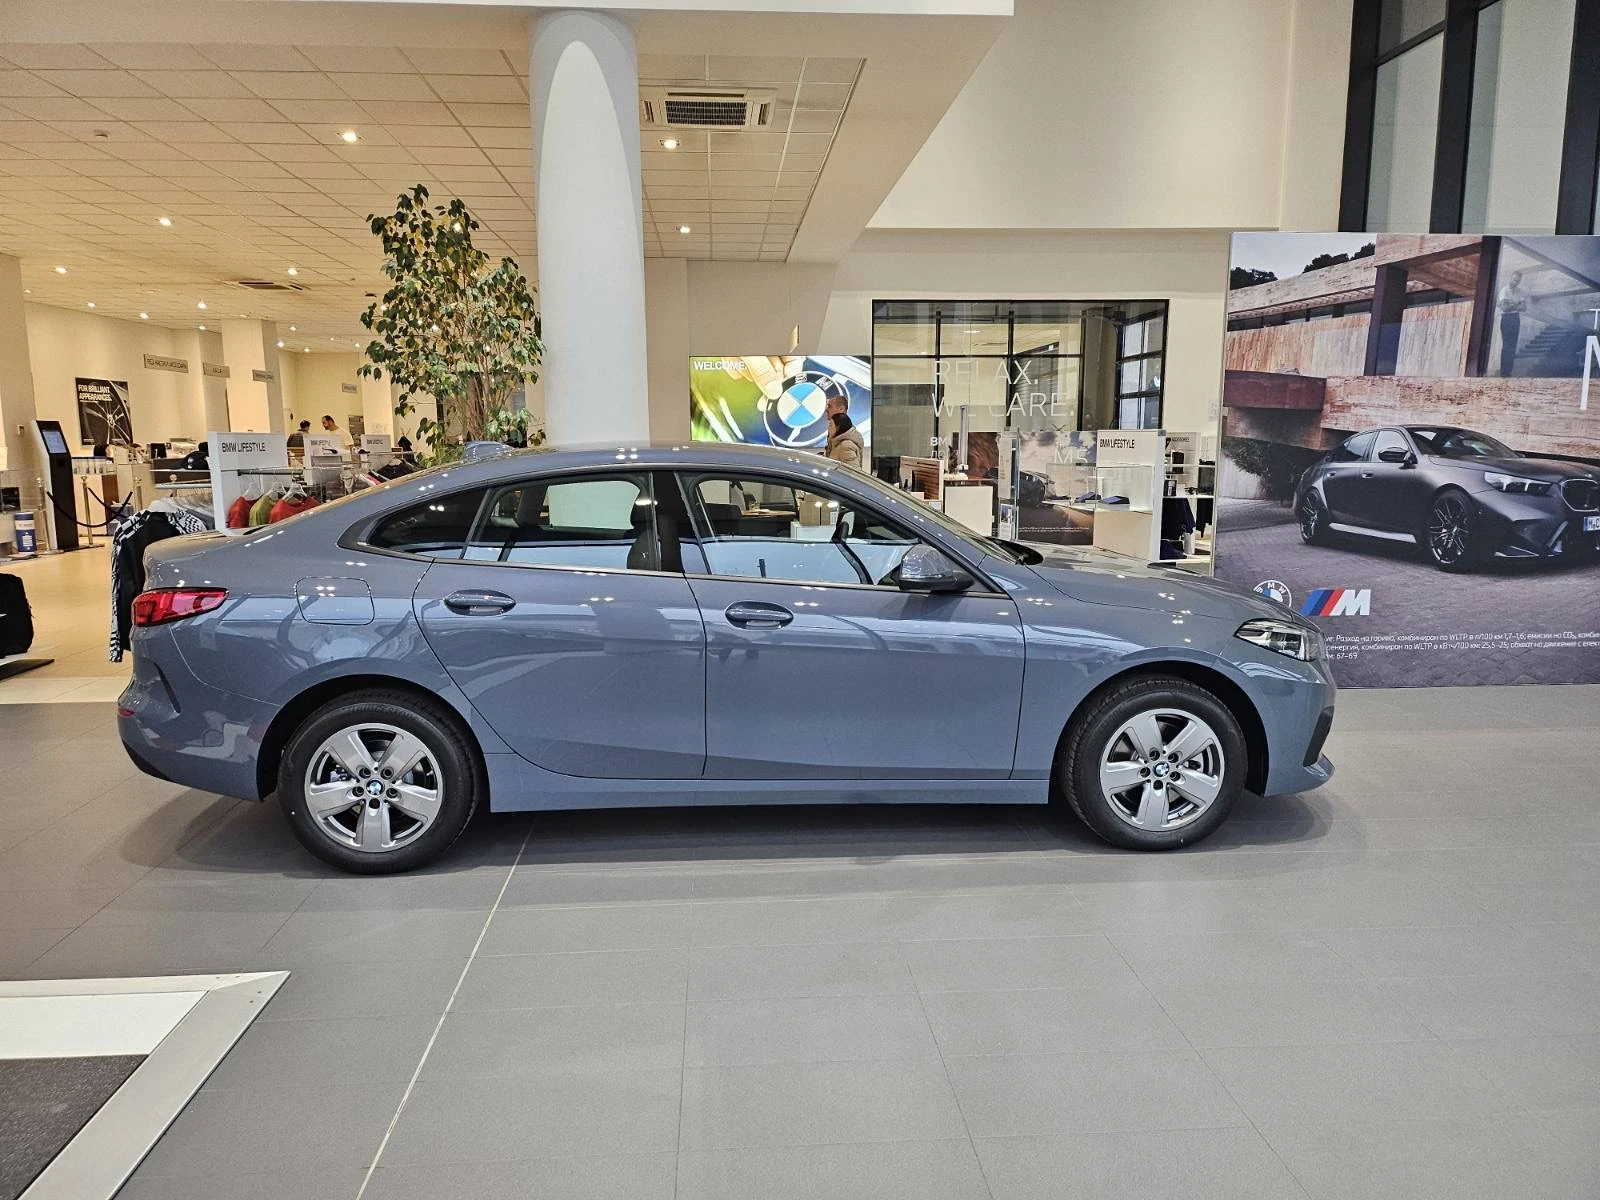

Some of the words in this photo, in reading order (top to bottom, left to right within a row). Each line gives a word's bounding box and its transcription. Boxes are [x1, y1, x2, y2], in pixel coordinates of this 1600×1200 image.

[933, 360, 1039, 385] RELAX.
[78, 384, 88, 392] FOR
[88, 385, 111, 393] BRILLIANT
[221, 442, 236, 452] BMW
[237, 442, 266, 452] LIFESTYLE
[1100, 438, 1110, 448] BMW
[1110, 439, 1135, 449] LIFESTYLE
[1449, 633, 1468, 641] WLTP
[1414, 642, 1432, 650] WLTP
